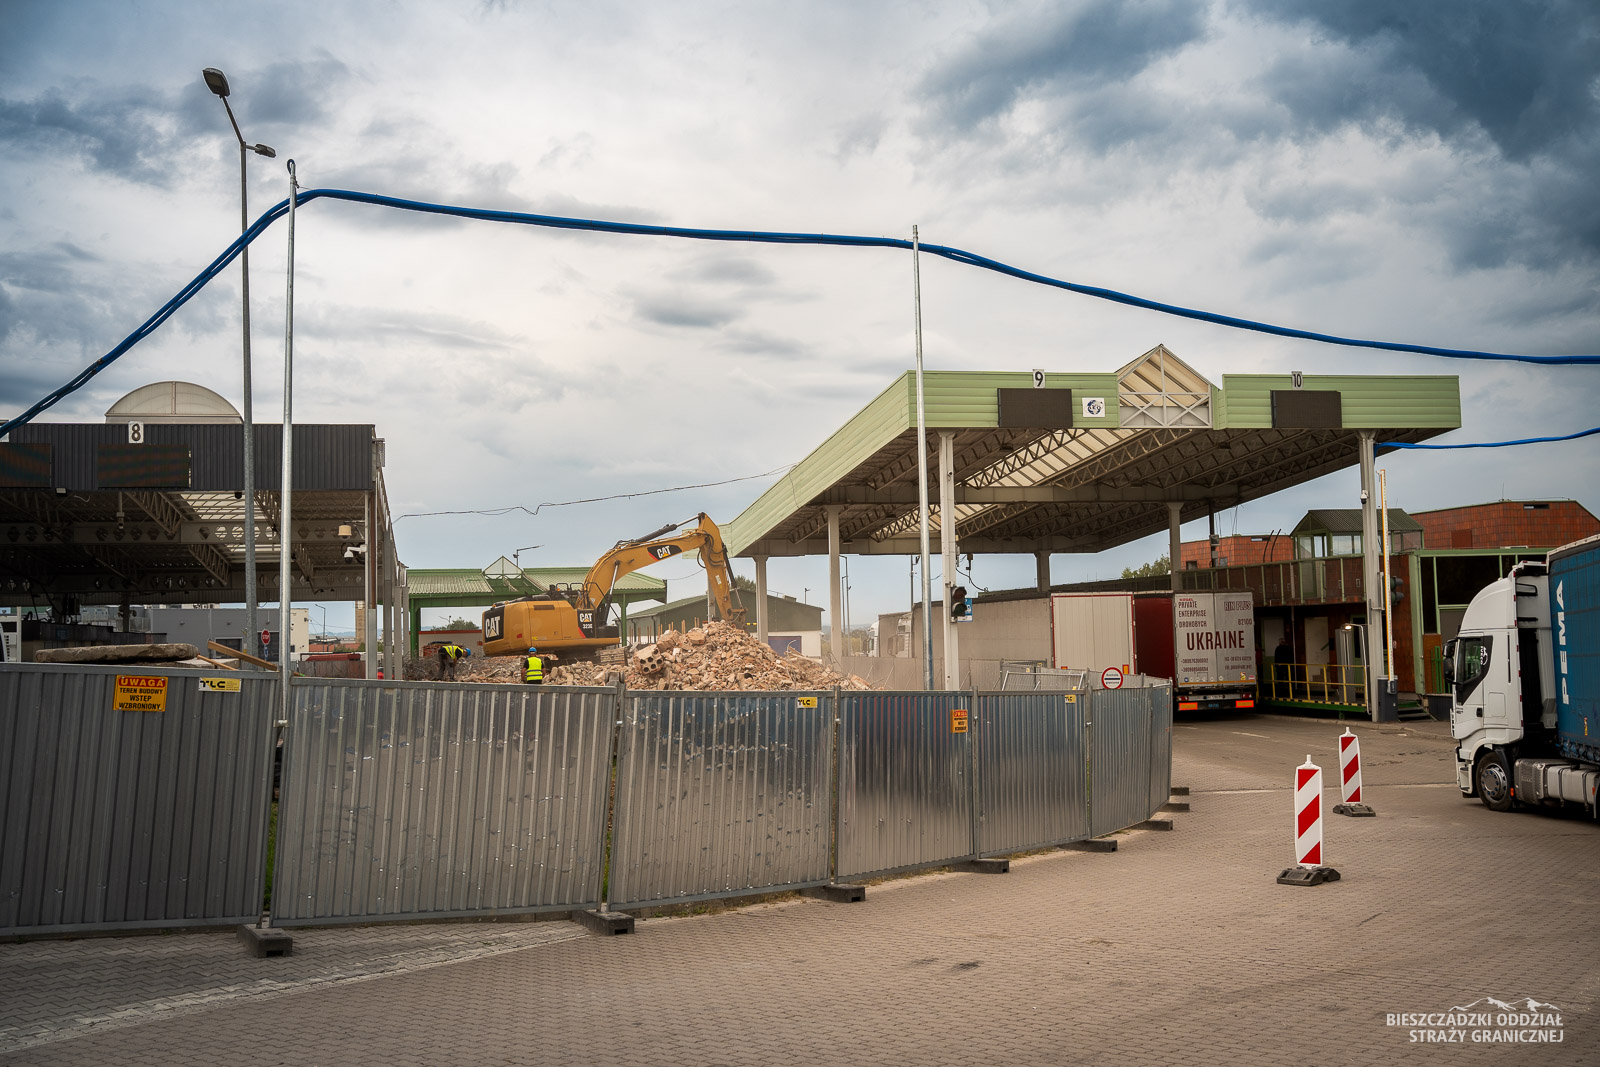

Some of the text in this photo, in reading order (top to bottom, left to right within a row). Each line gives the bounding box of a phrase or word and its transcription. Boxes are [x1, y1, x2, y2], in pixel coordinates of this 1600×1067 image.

[1034, 371, 1044, 387] 9
[1292, 373, 1302, 388] 10
[131, 423, 141, 442] 8
[656, 545, 671, 559] CAT
[1178, 601, 1198, 609] PRIVATE
[1236, 601, 1252, 611] PLUS
[579, 612, 593, 623] CAT
[1178, 610, 1207, 618] ENTERPRISE
[485, 615, 501, 639] CAT
[1186, 630, 1246, 651] UKRAINE
[1556, 579, 1570, 705] PEMA
[120, 679, 164, 687] UWAGA
[200, 680, 226, 688] TLC
[118, 702, 161, 710] WZBRONIONY
